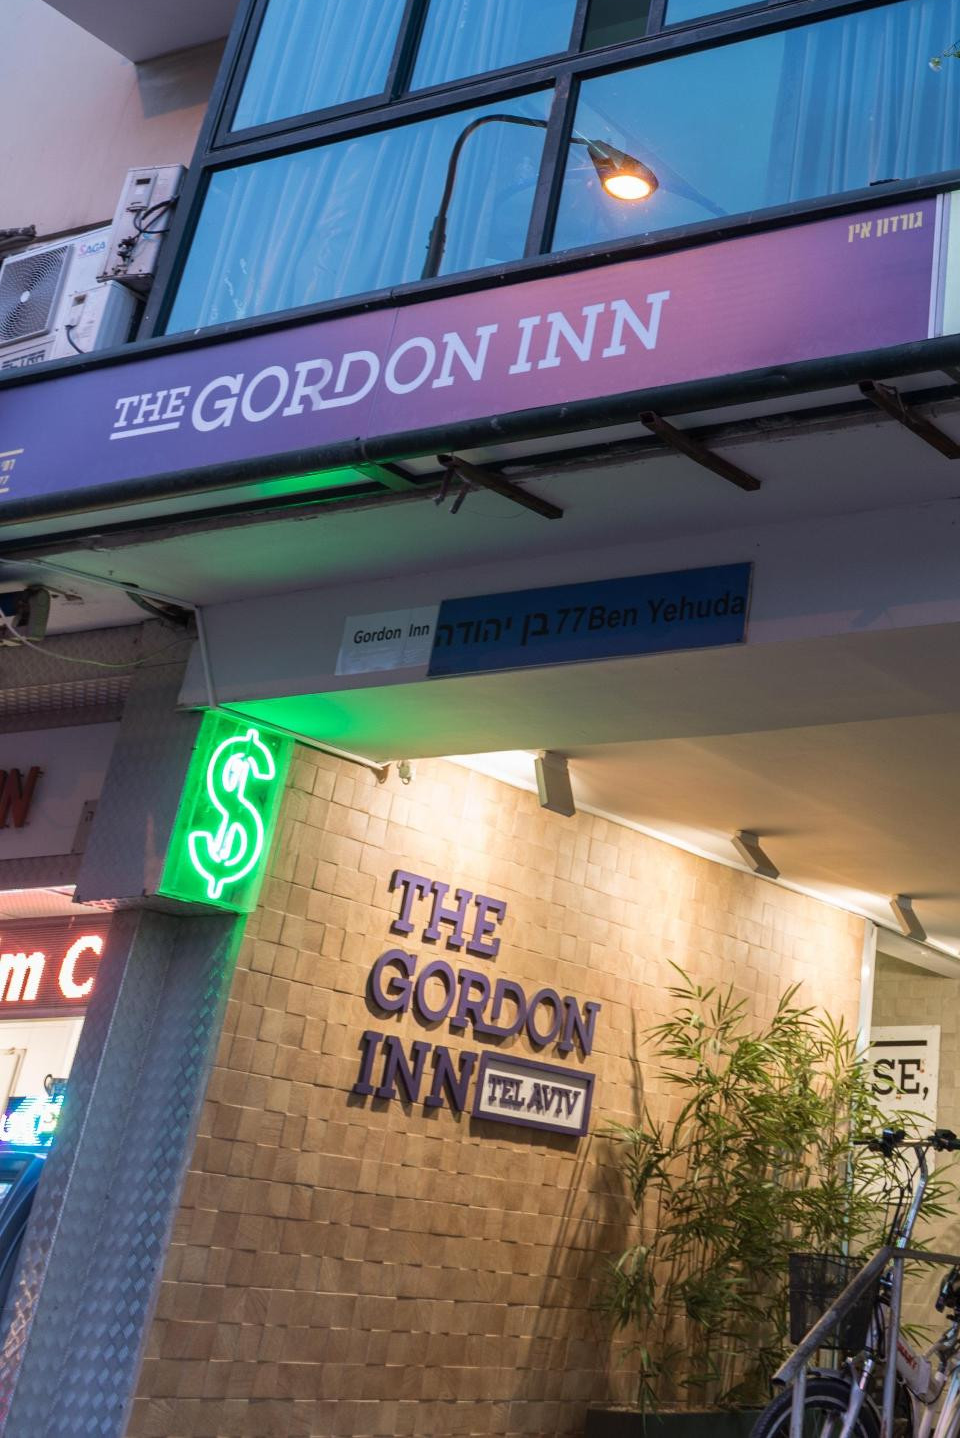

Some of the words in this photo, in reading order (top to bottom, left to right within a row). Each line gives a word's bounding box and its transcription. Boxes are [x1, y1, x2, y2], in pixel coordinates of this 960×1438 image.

[848, 221, 872, 243] אין
[876, 210, 923, 238] גורדון
[112, 385, 192, 429] THE
[191, 322, 498, 432] GORDON
[508, 290, 671, 375] INN
[648, 591, 746, 624] Yehuda
[353, 626, 402, 644] Gordon
[408, 624, 430, 638] Inn
[434, 616, 513, 648] יהודה
[519, 613, 550, 647] בן
[390, 869, 507, 956] THE
[370, 948, 602, 1056] GORDON
[353, 1029, 478, 1112] INN
[488, 1073, 526, 1107] TEL
[526, 1081, 582, 1116] AVIV
